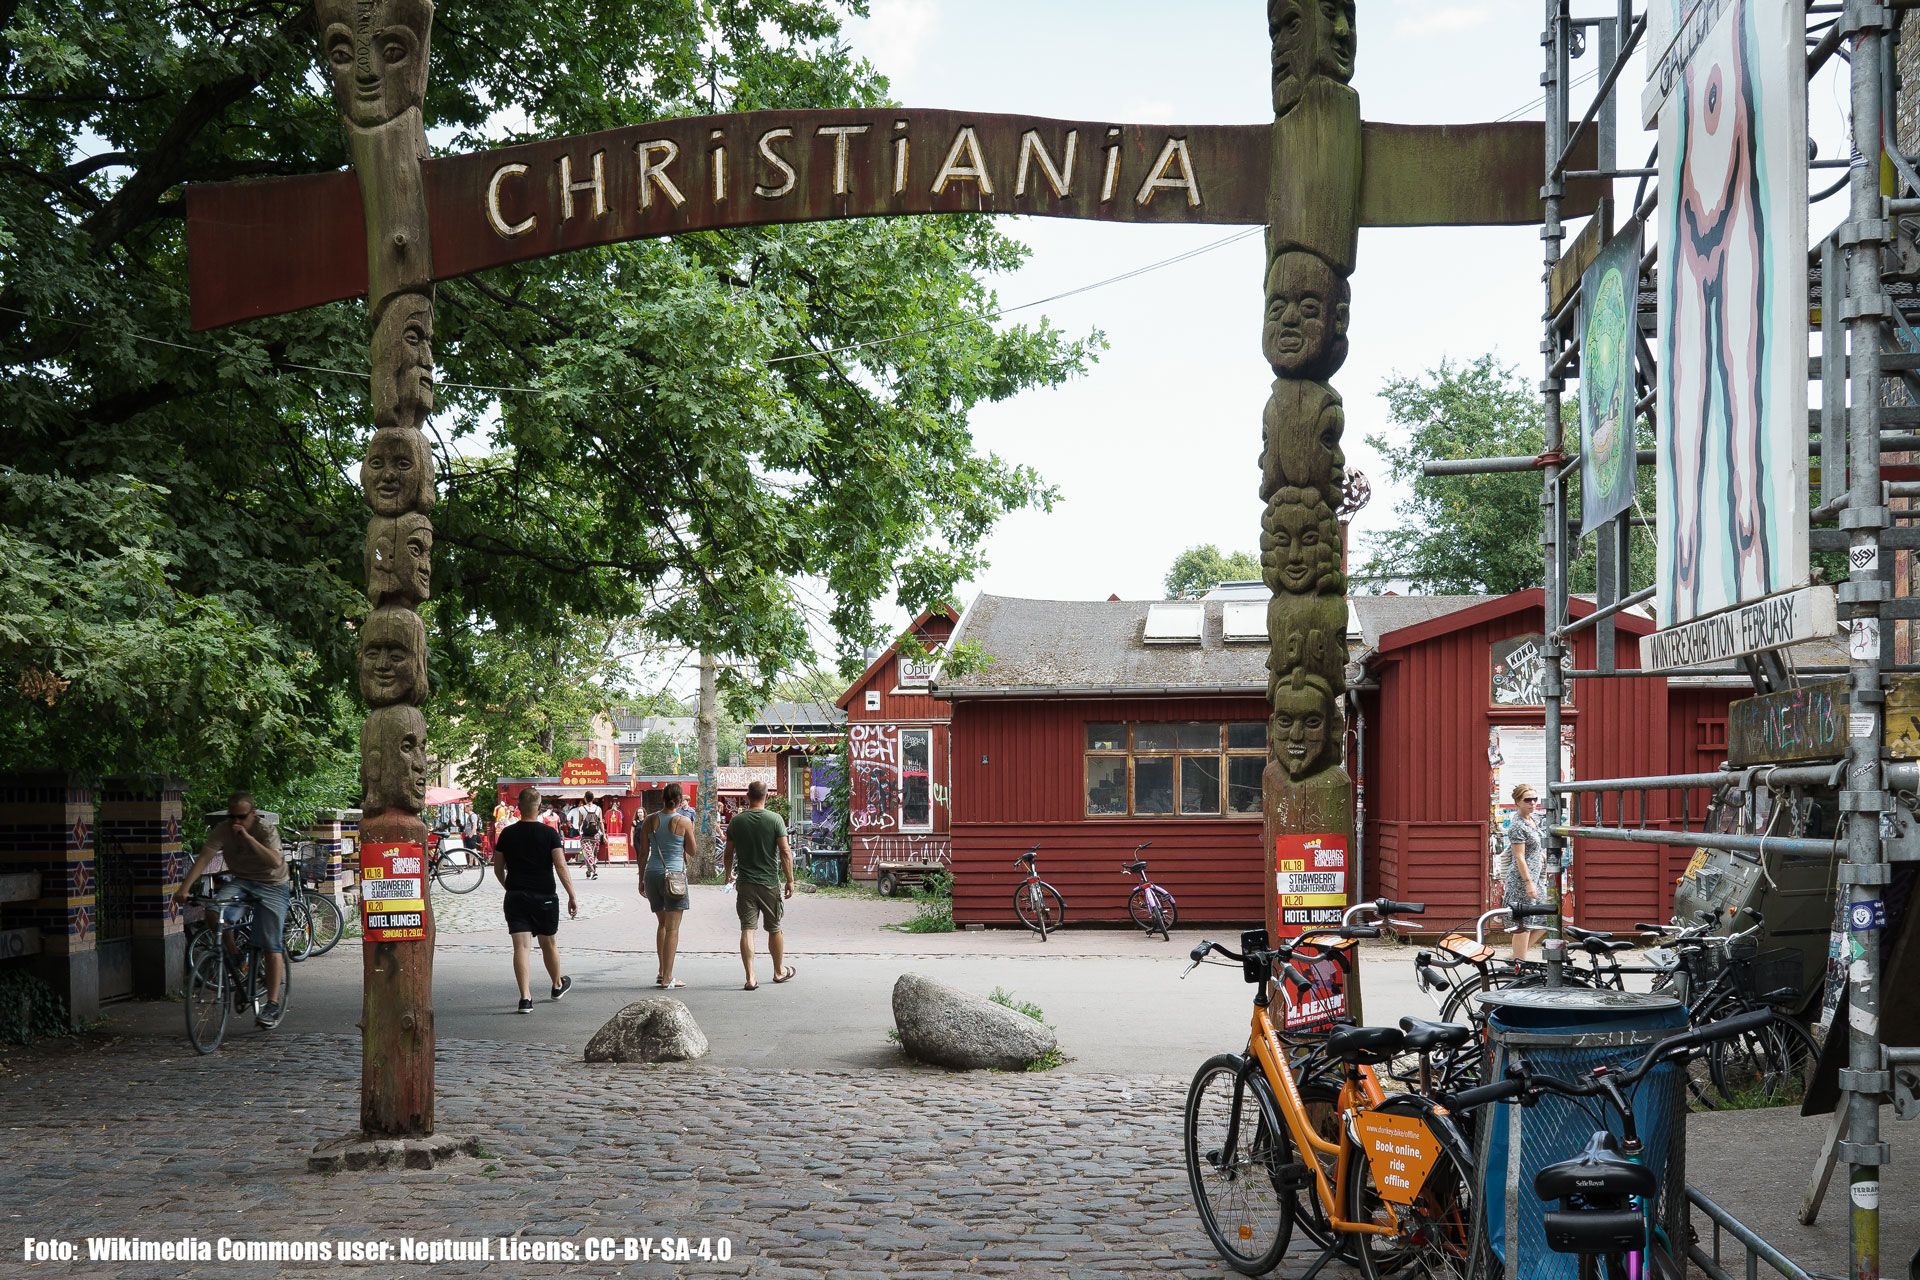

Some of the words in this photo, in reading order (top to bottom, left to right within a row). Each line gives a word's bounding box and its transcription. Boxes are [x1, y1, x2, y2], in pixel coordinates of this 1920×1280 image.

[1650, 614, 1735, 670] WINTEREXHIBITION
[1510, 644, 1534, 666] KOKO
[371, 880, 414, 891] STRAWBERRY
[1288, 873, 1337, 884] STRAWBERRY
[371, 890, 414, 899] SLAUGHTERHOUSE
[1288, 883, 1336, 893] SLAUGHTERHOUSE
[368, 915, 389, 928] HOTEL
[390, 914, 421, 927] HUNGER
[1284, 910, 1310, 923] HOTEL
[1311, 909, 1342, 923] HUNGER
[1269, 1029, 1286, 1064] DONKEY
[1282, 1065, 1303, 1108] REPUBLIC
[1366, 1125, 1420, 1140] www.donkey.bike/offline
[1375, 1140, 1394, 1153] Book
[1395, 1144, 1422, 1160] online,
[1389, 1158, 1406, 1172] ride
[1384, 1174, 1410, 1189] offline
